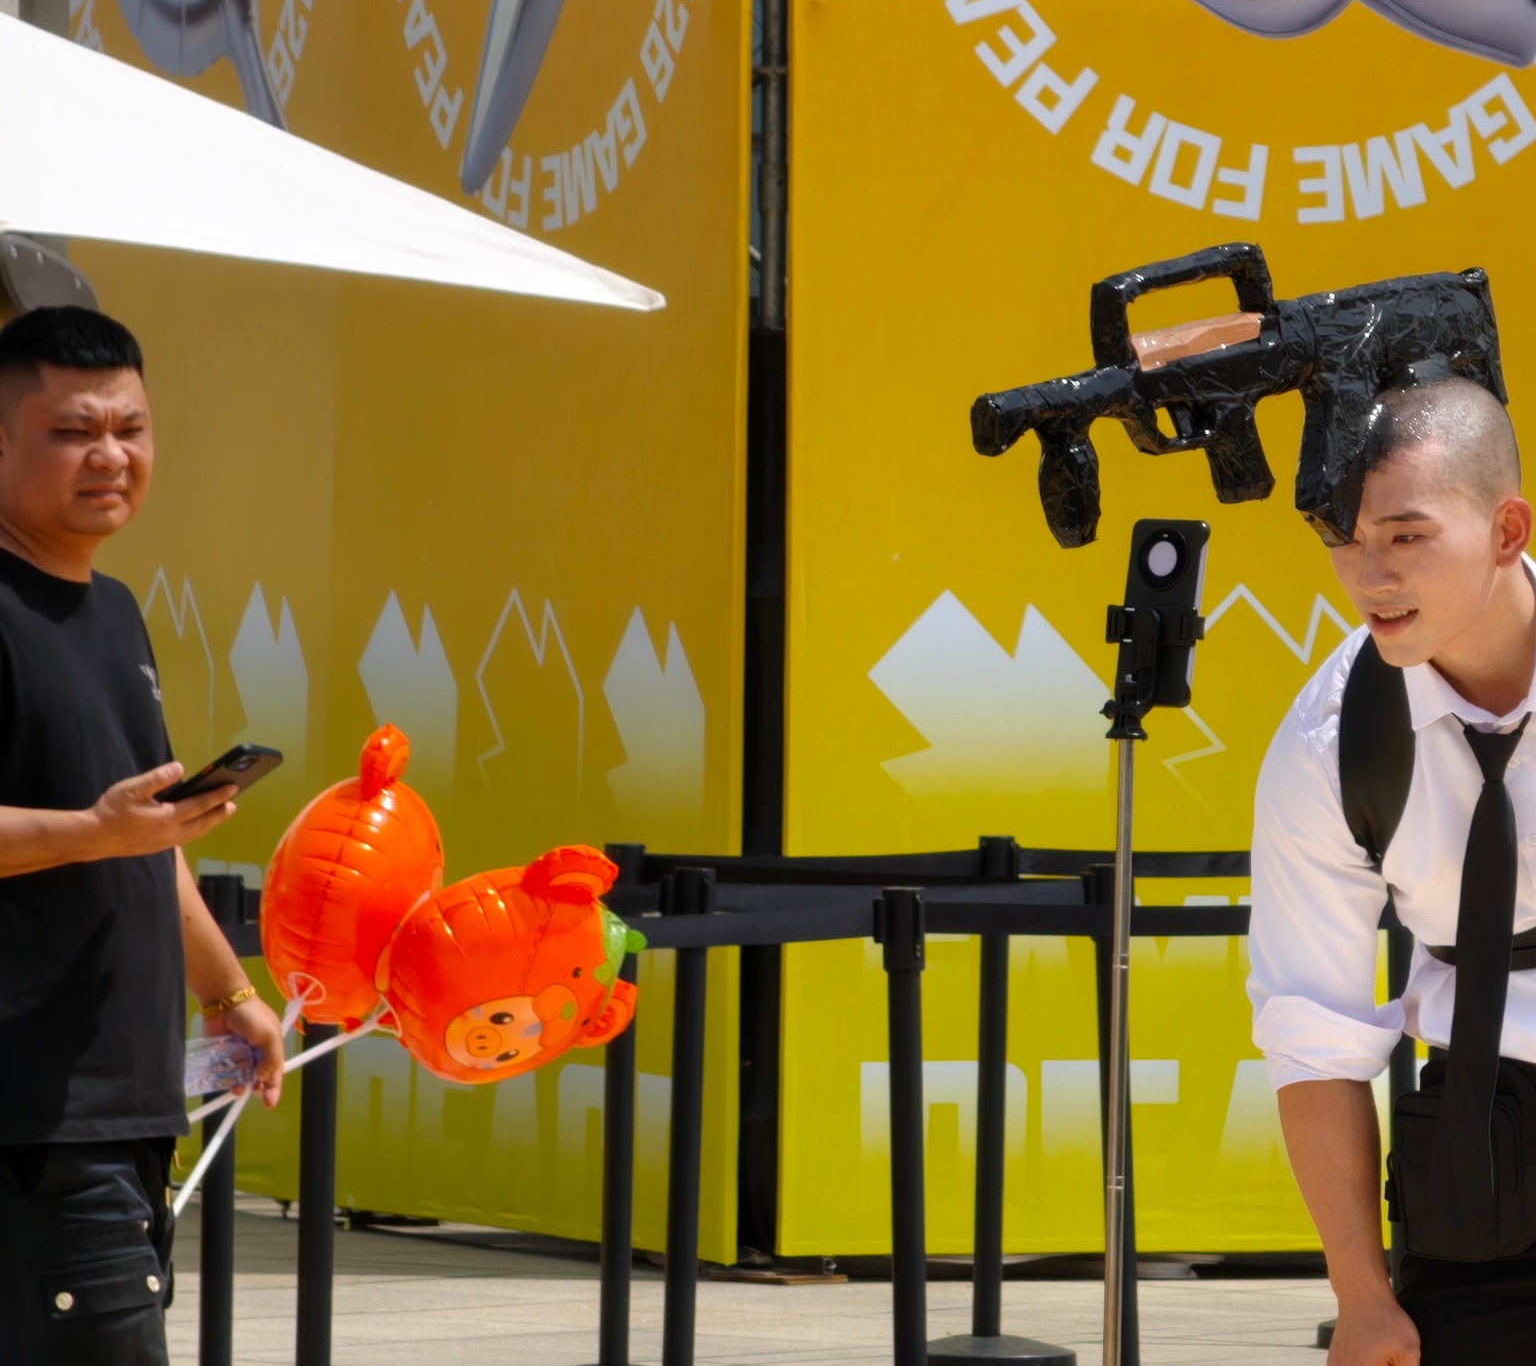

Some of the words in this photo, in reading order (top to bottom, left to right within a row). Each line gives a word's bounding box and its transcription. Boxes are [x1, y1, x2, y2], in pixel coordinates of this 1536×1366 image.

[459, 144, 532, 230] FO
[541, 75, 648, 232] GAME
[1090, 93, 1270, 222] FOR
